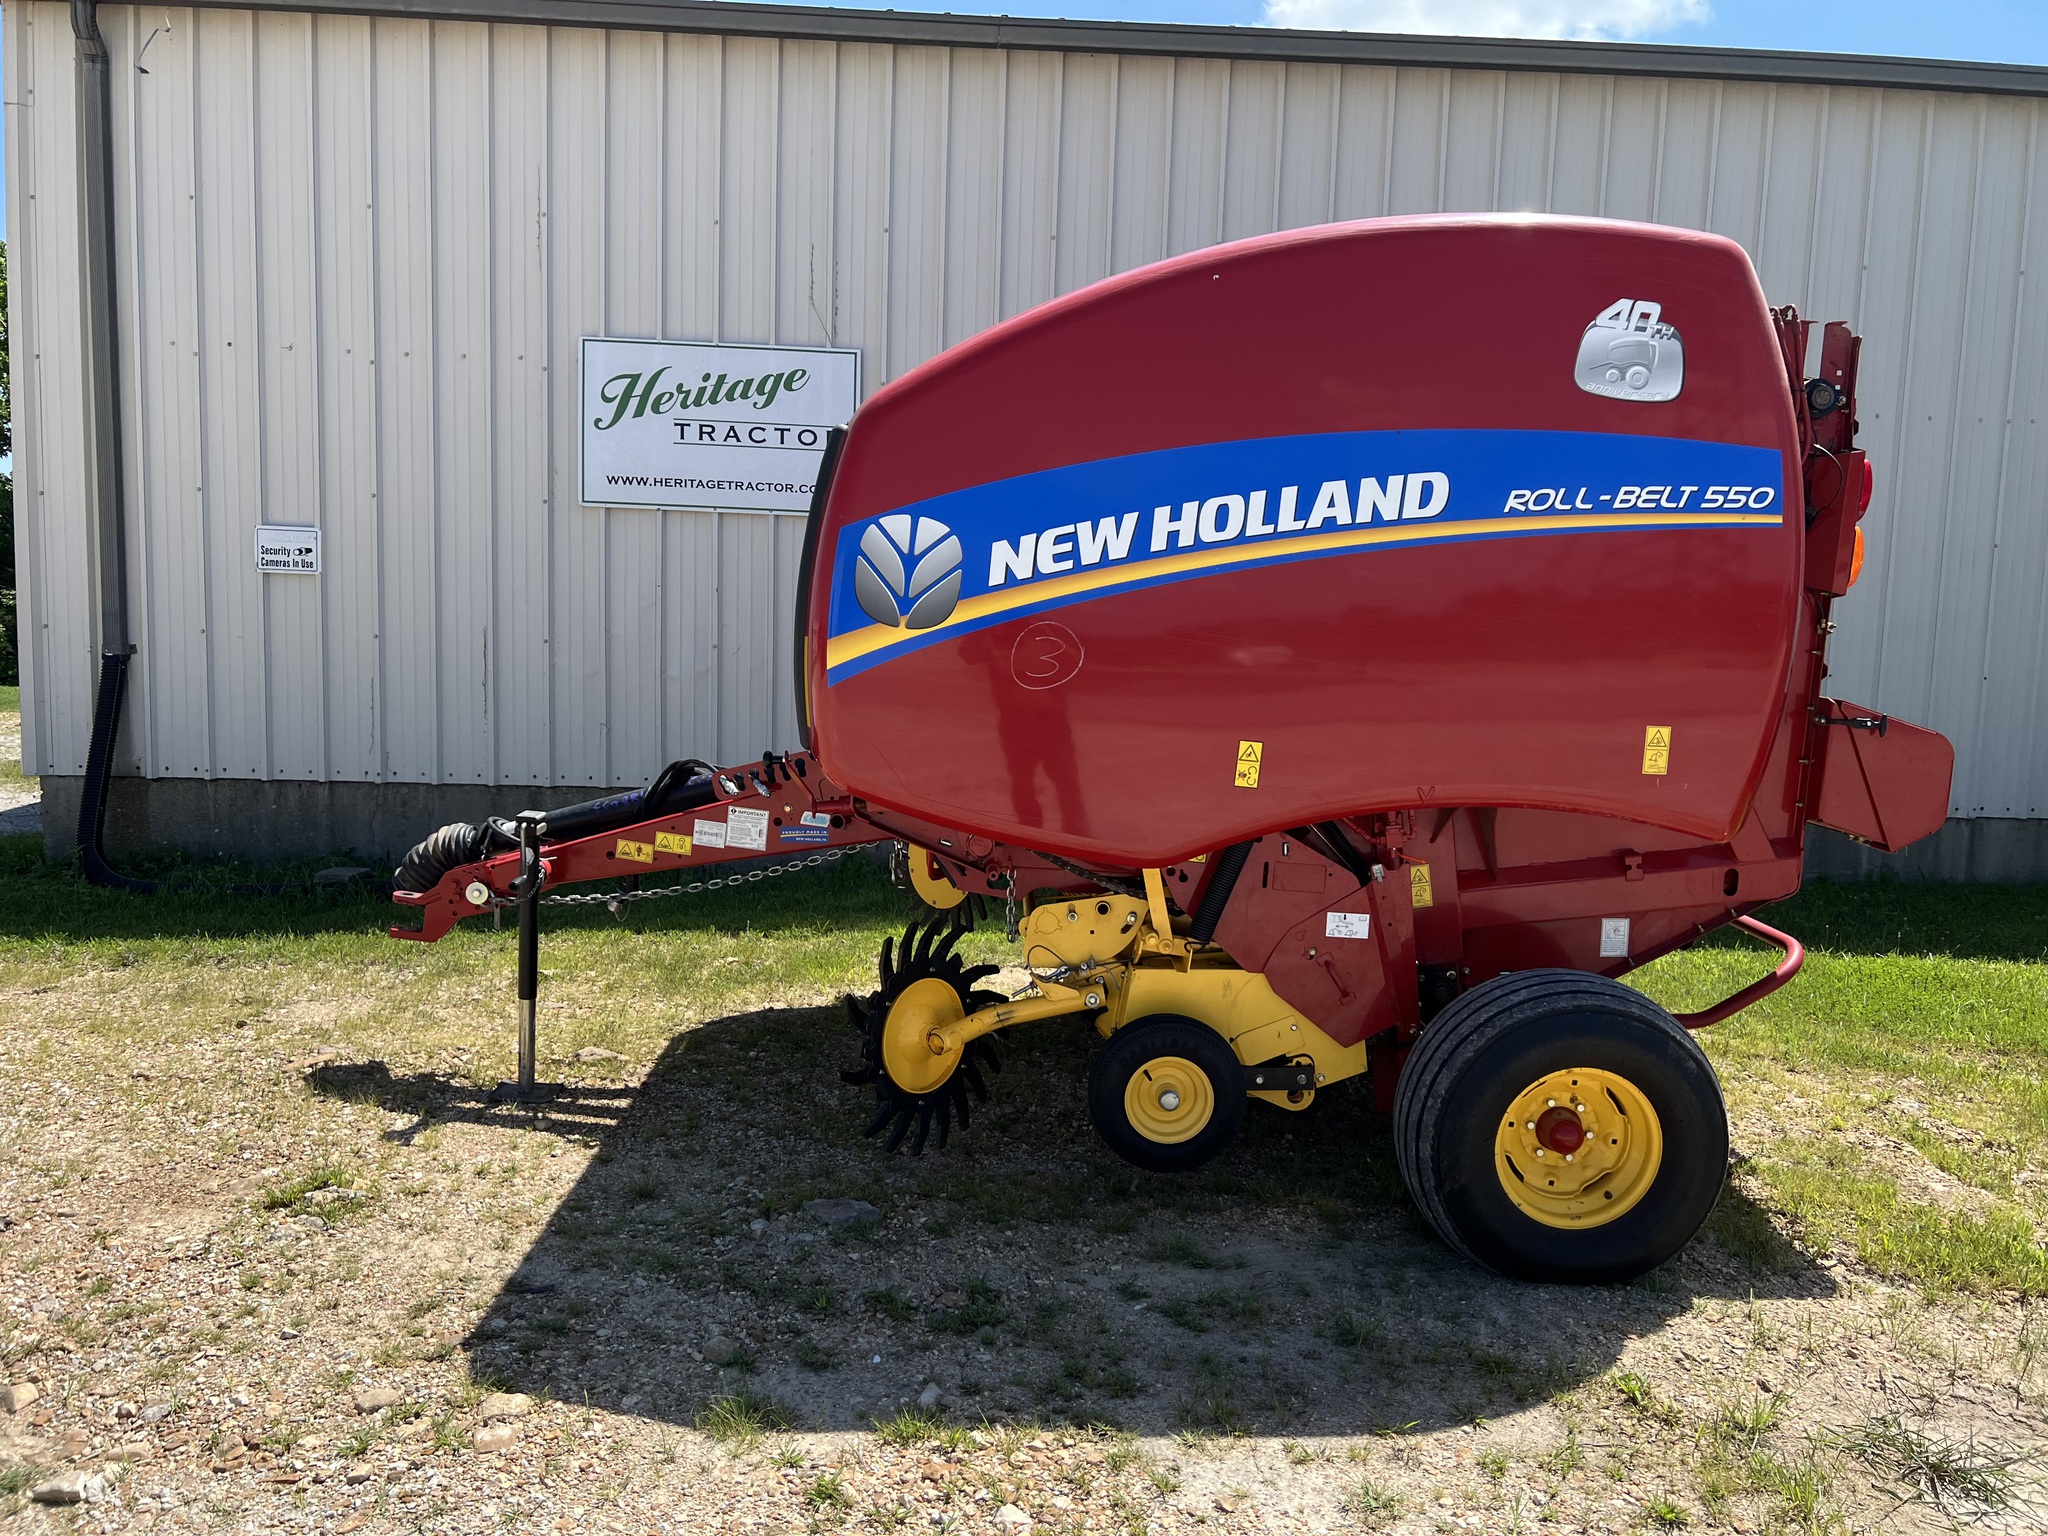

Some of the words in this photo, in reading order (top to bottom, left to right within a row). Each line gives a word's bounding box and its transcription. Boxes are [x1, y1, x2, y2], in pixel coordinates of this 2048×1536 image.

[593, 365, 811, 431] Heritage
[1586, 382, 1670, 400] anniversary
[606, 475, 816, 494] WWW.HERITAGETRACTOR.CO
[1700, 486, 1776, 510] 550
[987, 511, 1140, 587] NEW
[1150, 470, 1451, 554] HOLLAND
[260, 545, 291, 558] Security
[260, 557, 291, 568] Cameras
[292, 558, 300, 568] In
[301, 558, 314, 569] Use
[1025, 636, 1067, 678] 3
[737, 809, 767, 818] IMPORTANT
